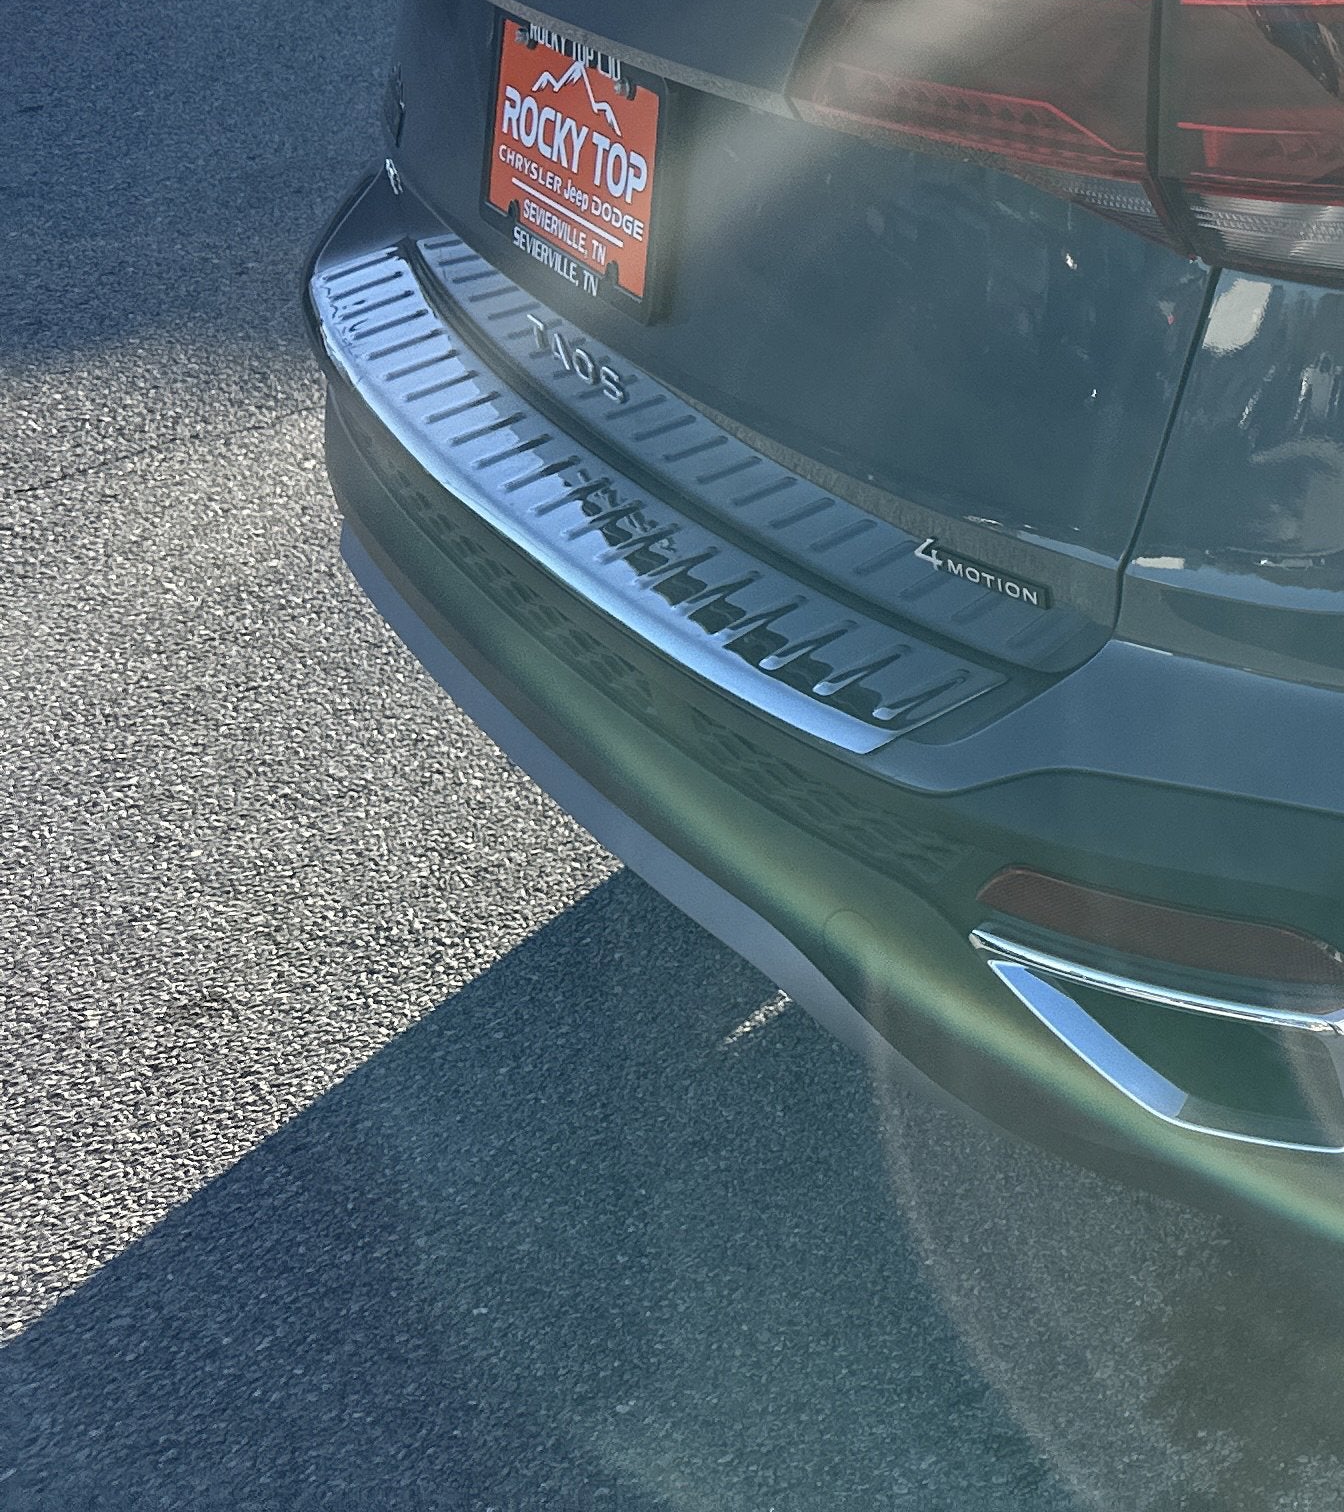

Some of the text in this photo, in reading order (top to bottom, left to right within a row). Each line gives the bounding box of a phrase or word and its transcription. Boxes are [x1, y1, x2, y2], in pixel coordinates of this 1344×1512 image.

[502, 86, 648, 204] ROCKY TOP
[499, 144, 644, 242] CHRYSLER Jeep DODGE
[523, 199, 607, 266] SEVIERVILLE, TN
[513, 226, 599, 297] SEVIERVILLE, TN
[527, 313, 625, 404] TAOS
[914, 538, 1038, 605] 4MOTION
